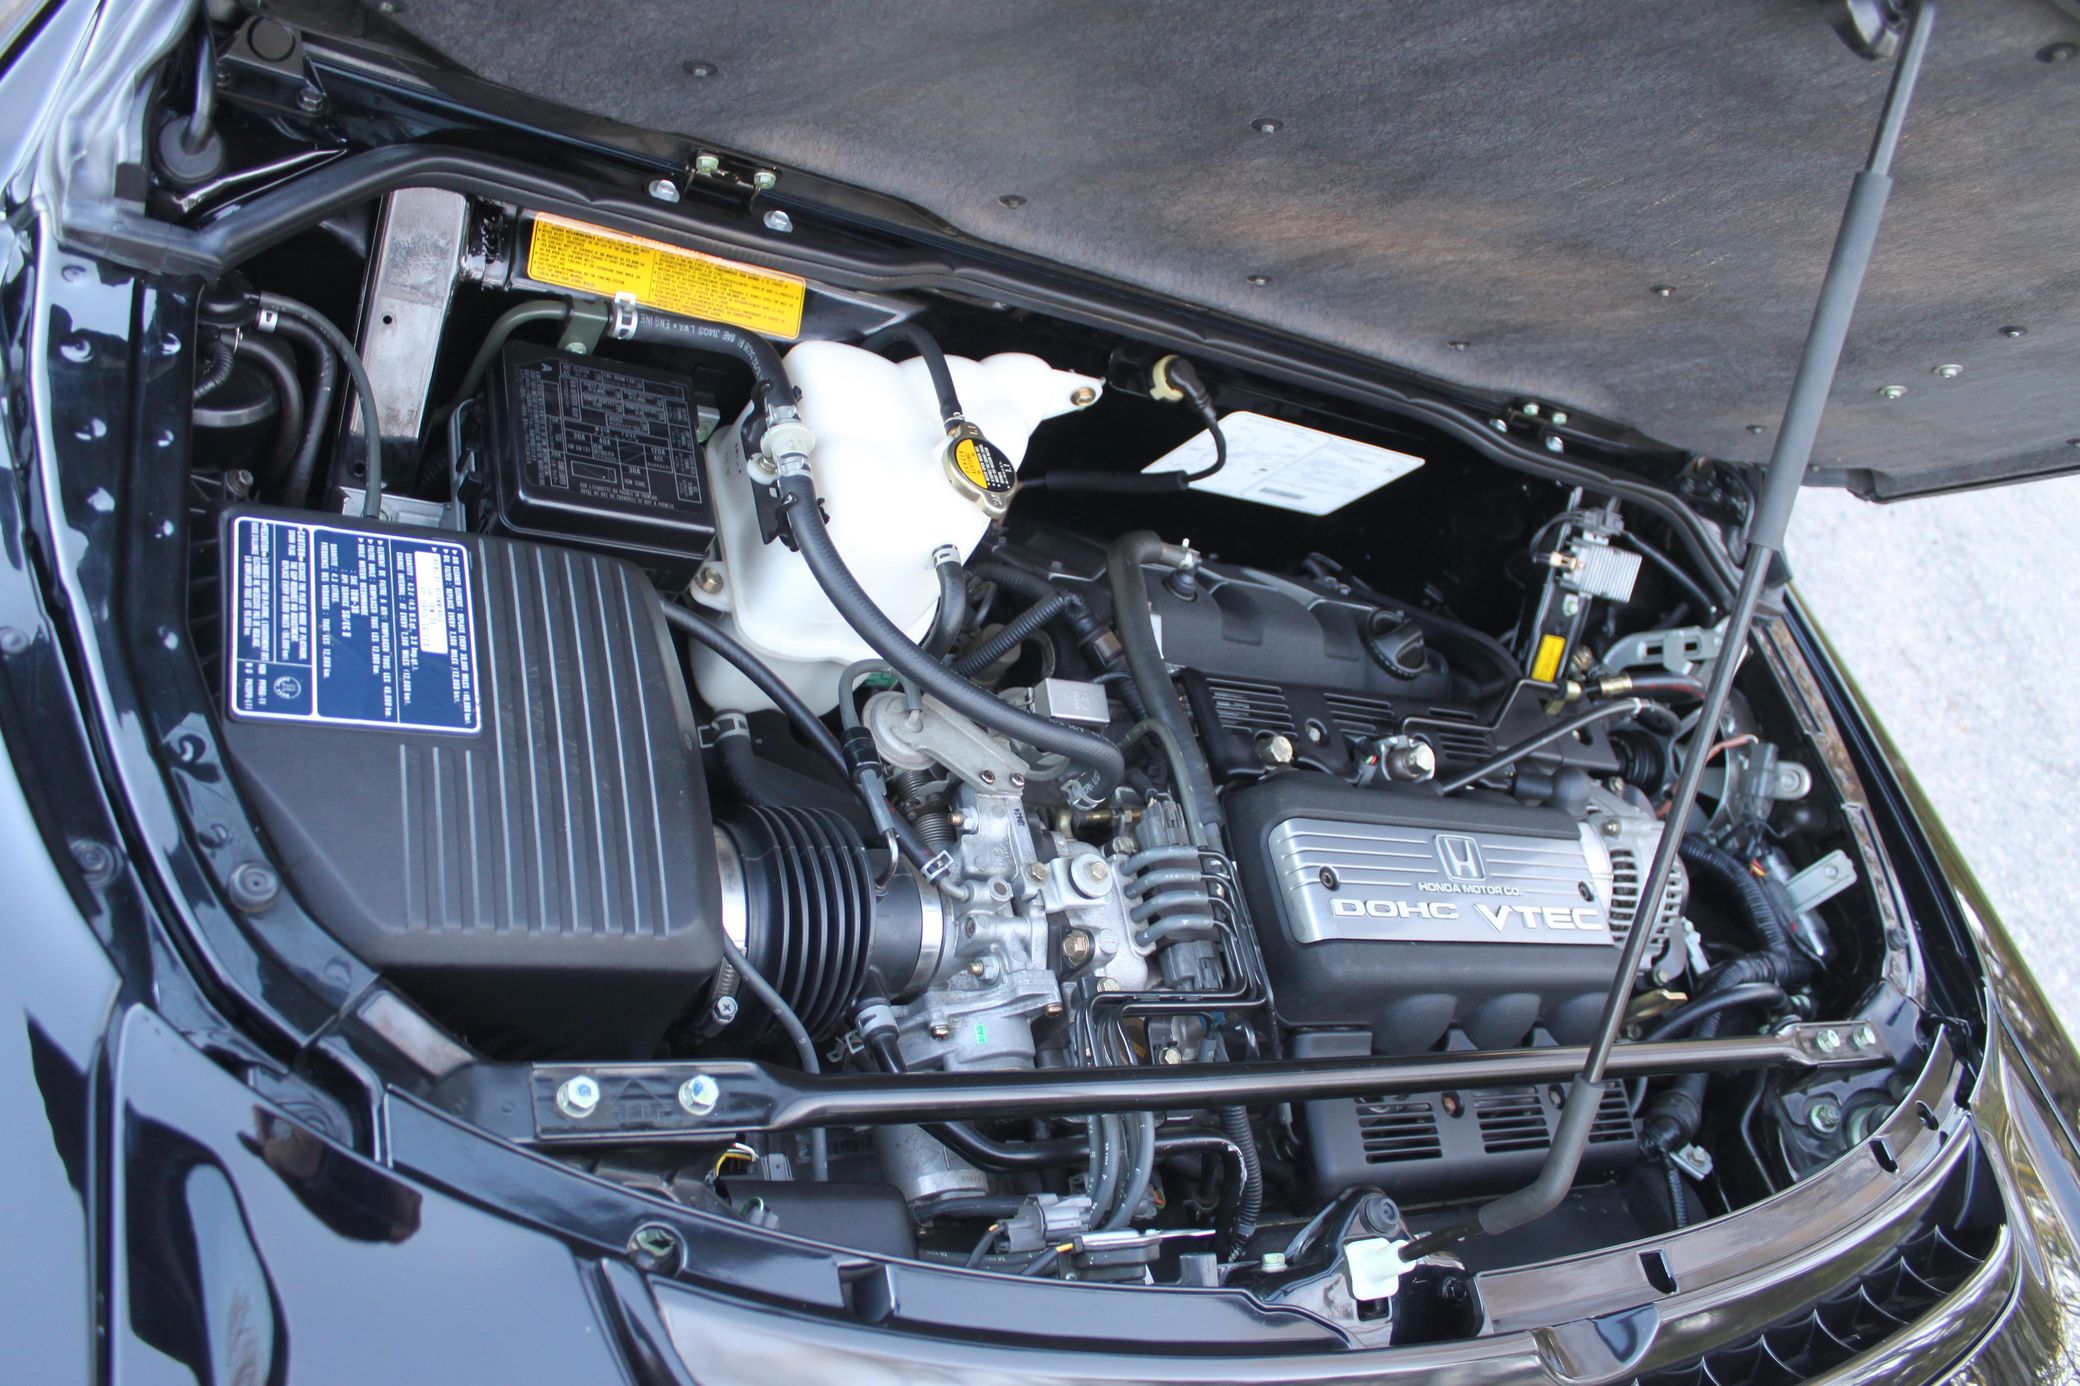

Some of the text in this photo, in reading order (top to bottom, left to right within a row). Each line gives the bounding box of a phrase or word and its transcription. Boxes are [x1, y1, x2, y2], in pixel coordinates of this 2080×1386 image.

[640, 313, 671, 330] ENGINE
[541, 363, 553, 372] A
[350, 588, 358, 614] 10W-30
[1417, 881, 1461, 894] HONDA
[1461, 884, 1504, 895] MOTOR
[1330, 898, 1604, 934] DOHC VTEC
